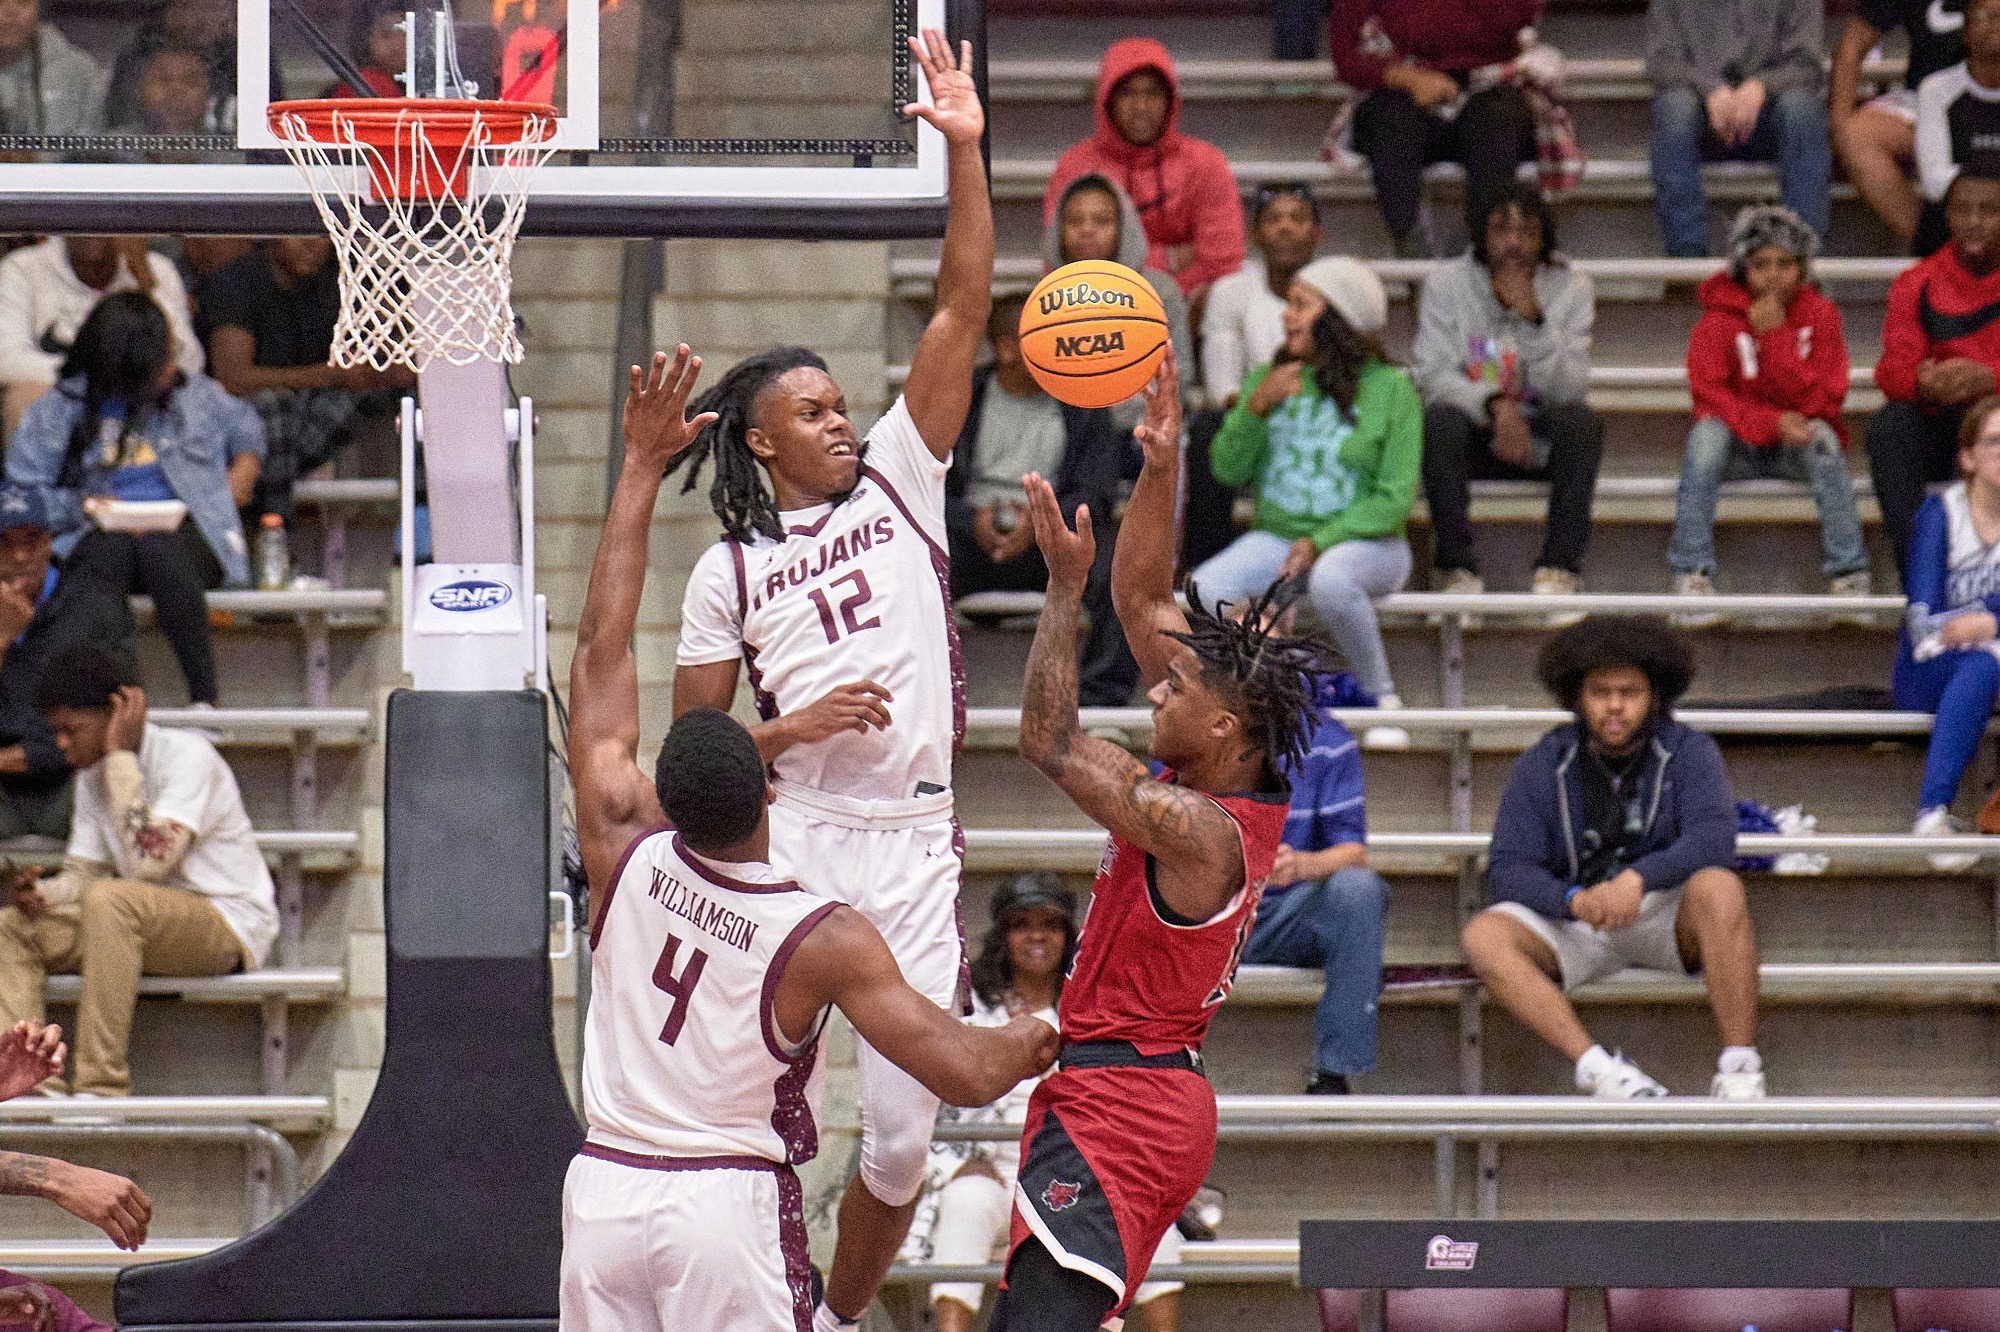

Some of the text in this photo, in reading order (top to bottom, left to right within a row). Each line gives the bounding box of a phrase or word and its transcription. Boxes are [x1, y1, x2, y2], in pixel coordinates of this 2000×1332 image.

[1039, 282, 1136, 315] Wilson
[1055, 331, 1125, 357] NCAA
[808, 568, 881, 645] 12
[648, 866, 759, 953] WILLIAMSON
[652, 932, 709, 1047] 4
